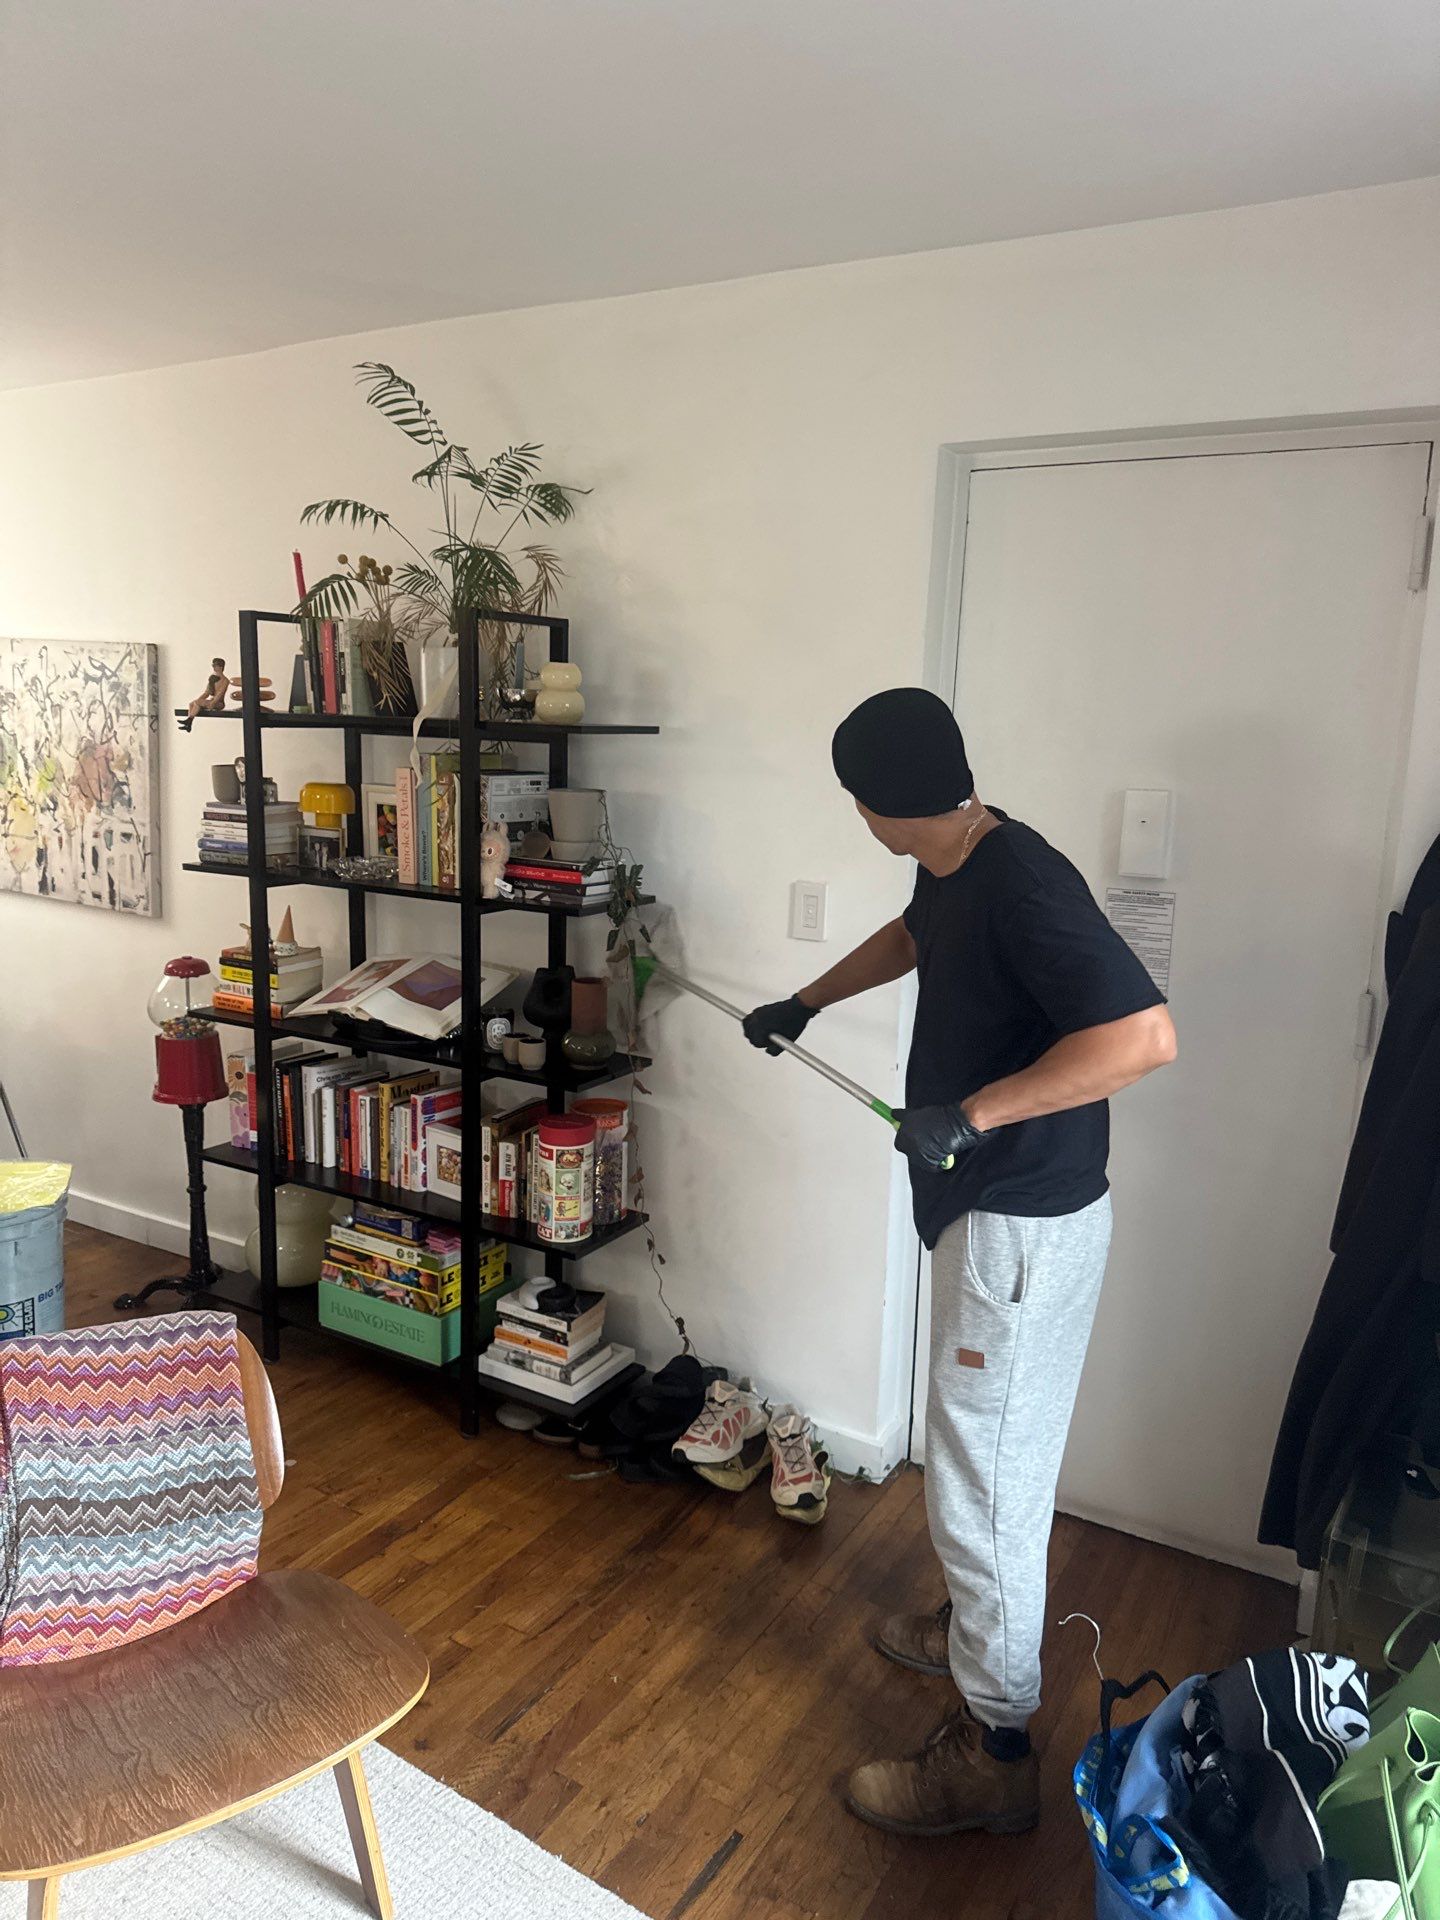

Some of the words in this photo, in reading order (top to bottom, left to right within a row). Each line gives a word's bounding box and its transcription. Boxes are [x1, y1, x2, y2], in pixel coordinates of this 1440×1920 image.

[401, 821, 410, 830] &
[400, 833, 410, 872] Smoke
[442, 1271, 454, 1285] LE
[38, 1288, 54, 1302] BIG
[440, 1292, 453, 1308] LE
[384, 1317, 425, 1343] ESTATE
